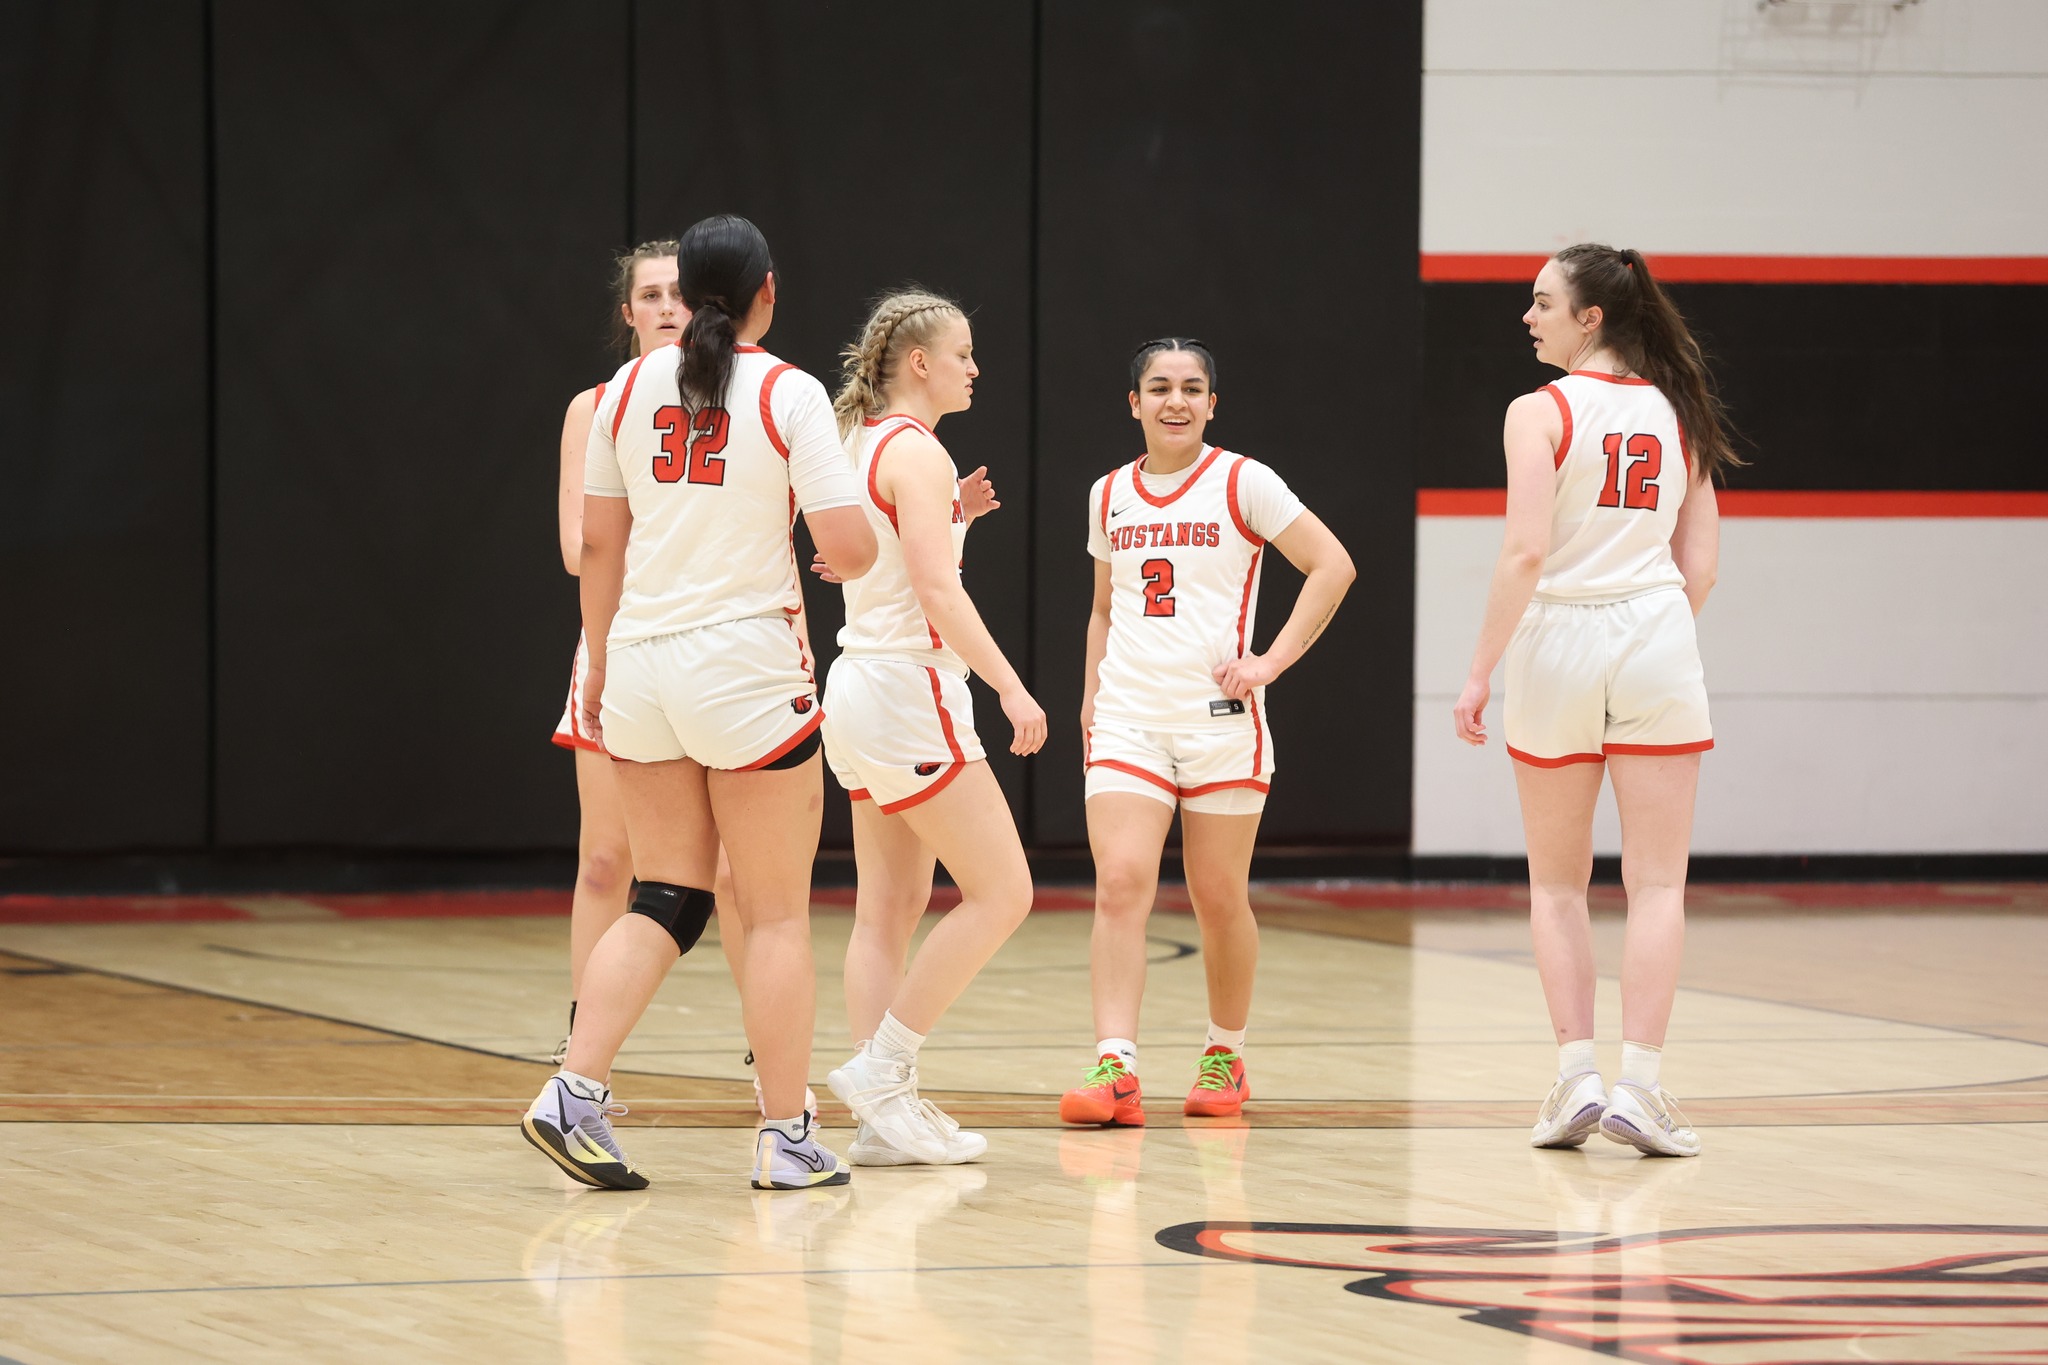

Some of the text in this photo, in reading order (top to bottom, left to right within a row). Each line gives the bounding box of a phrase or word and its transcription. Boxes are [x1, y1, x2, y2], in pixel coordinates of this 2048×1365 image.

[653, 405, 731, 486] 32
[1597, 432, 1662, 511] 12
[1110, 522, 1220, 552] MUSTANGS
[1141, 558, 1175, 617] 2
